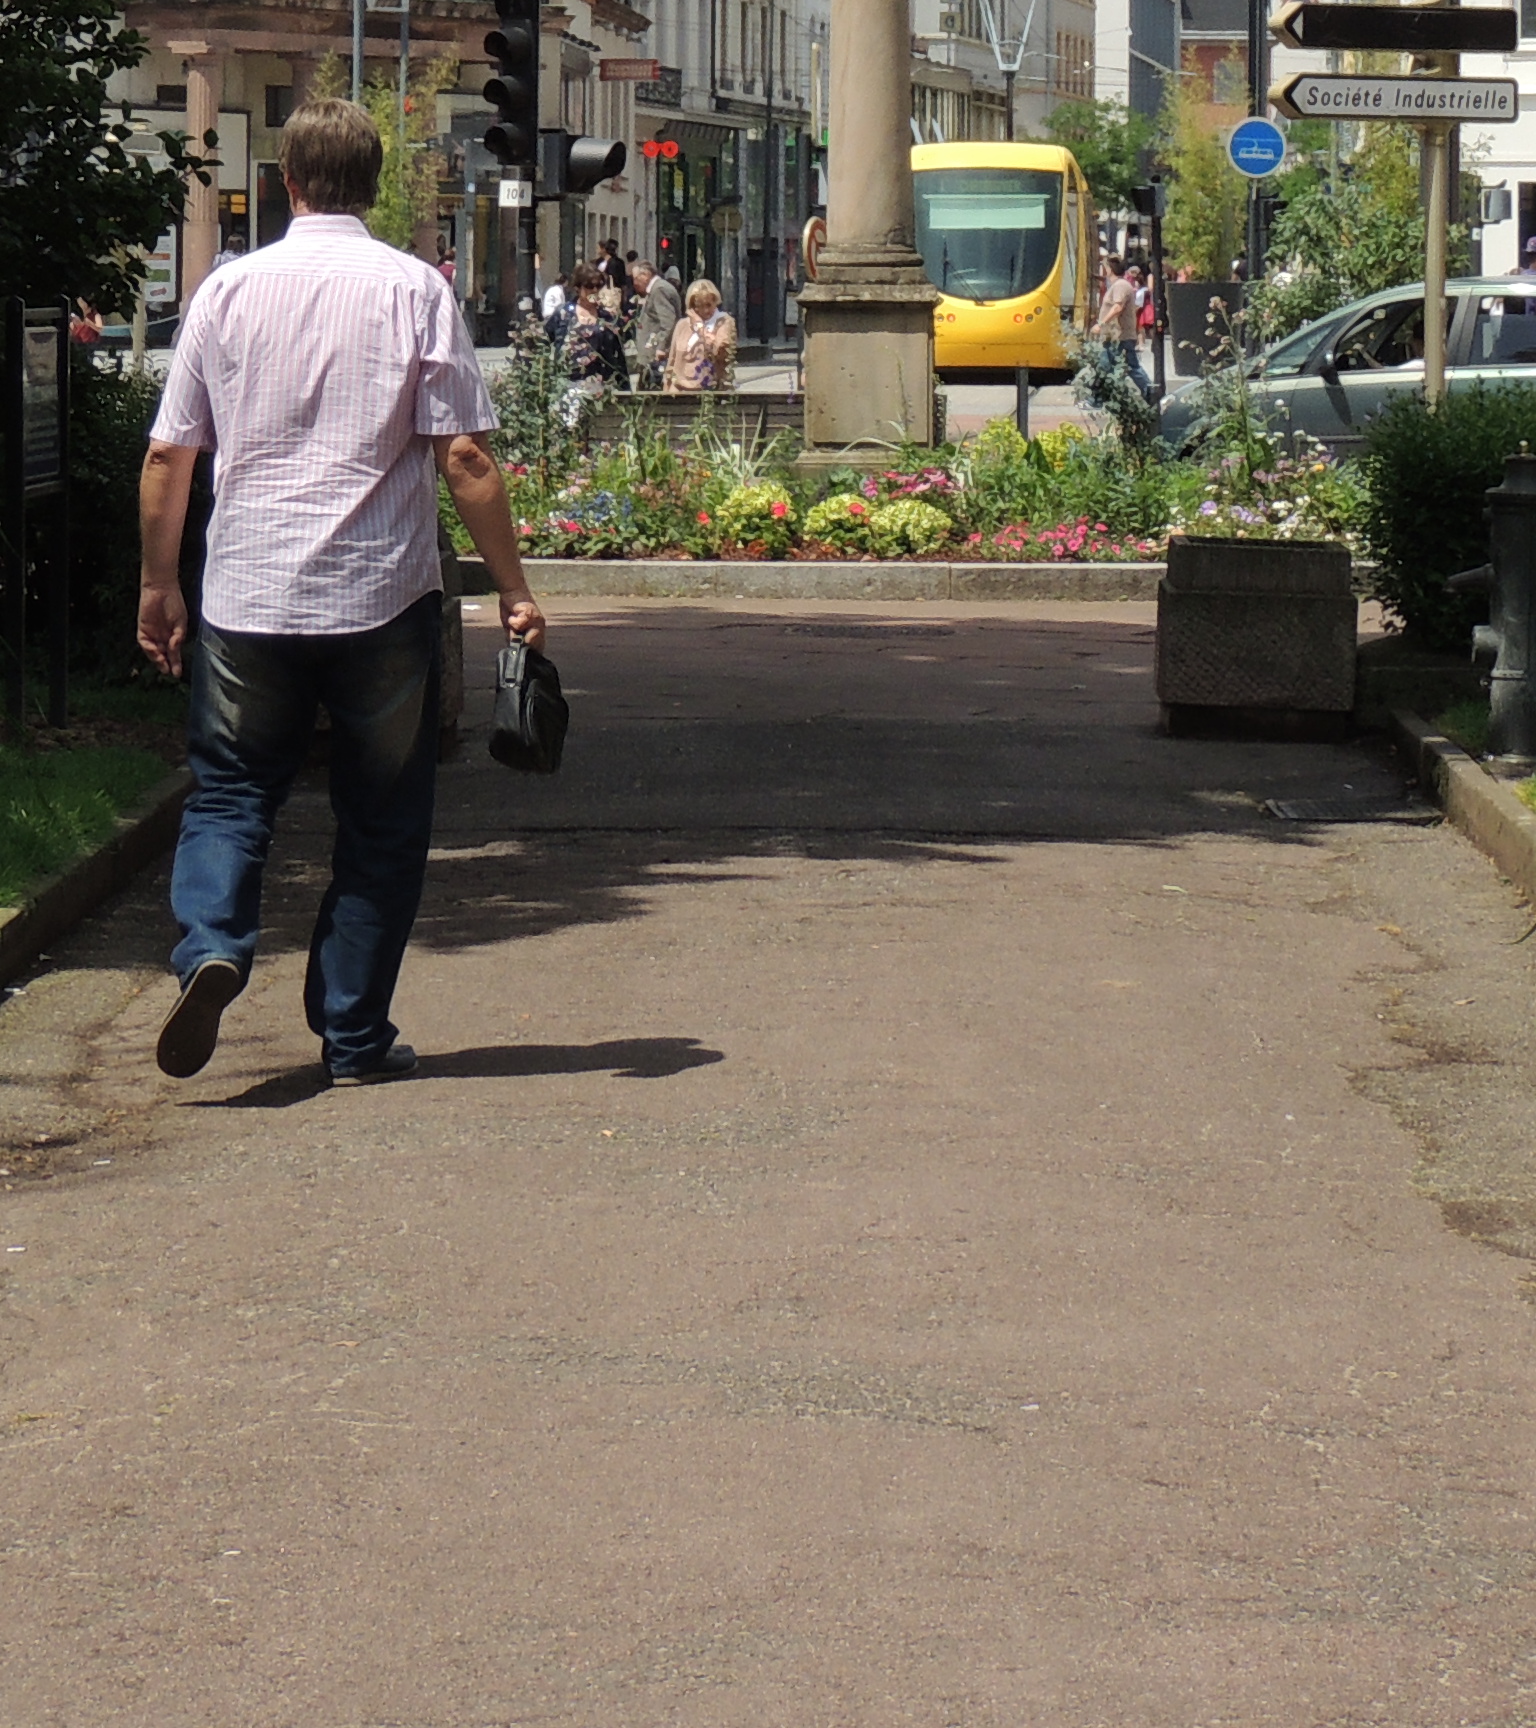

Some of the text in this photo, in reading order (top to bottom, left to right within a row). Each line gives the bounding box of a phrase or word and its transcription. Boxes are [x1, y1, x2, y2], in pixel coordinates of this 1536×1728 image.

[1306, 86, 1508, 110] Société Industrielle
[506, 188, 525, 200] 104
